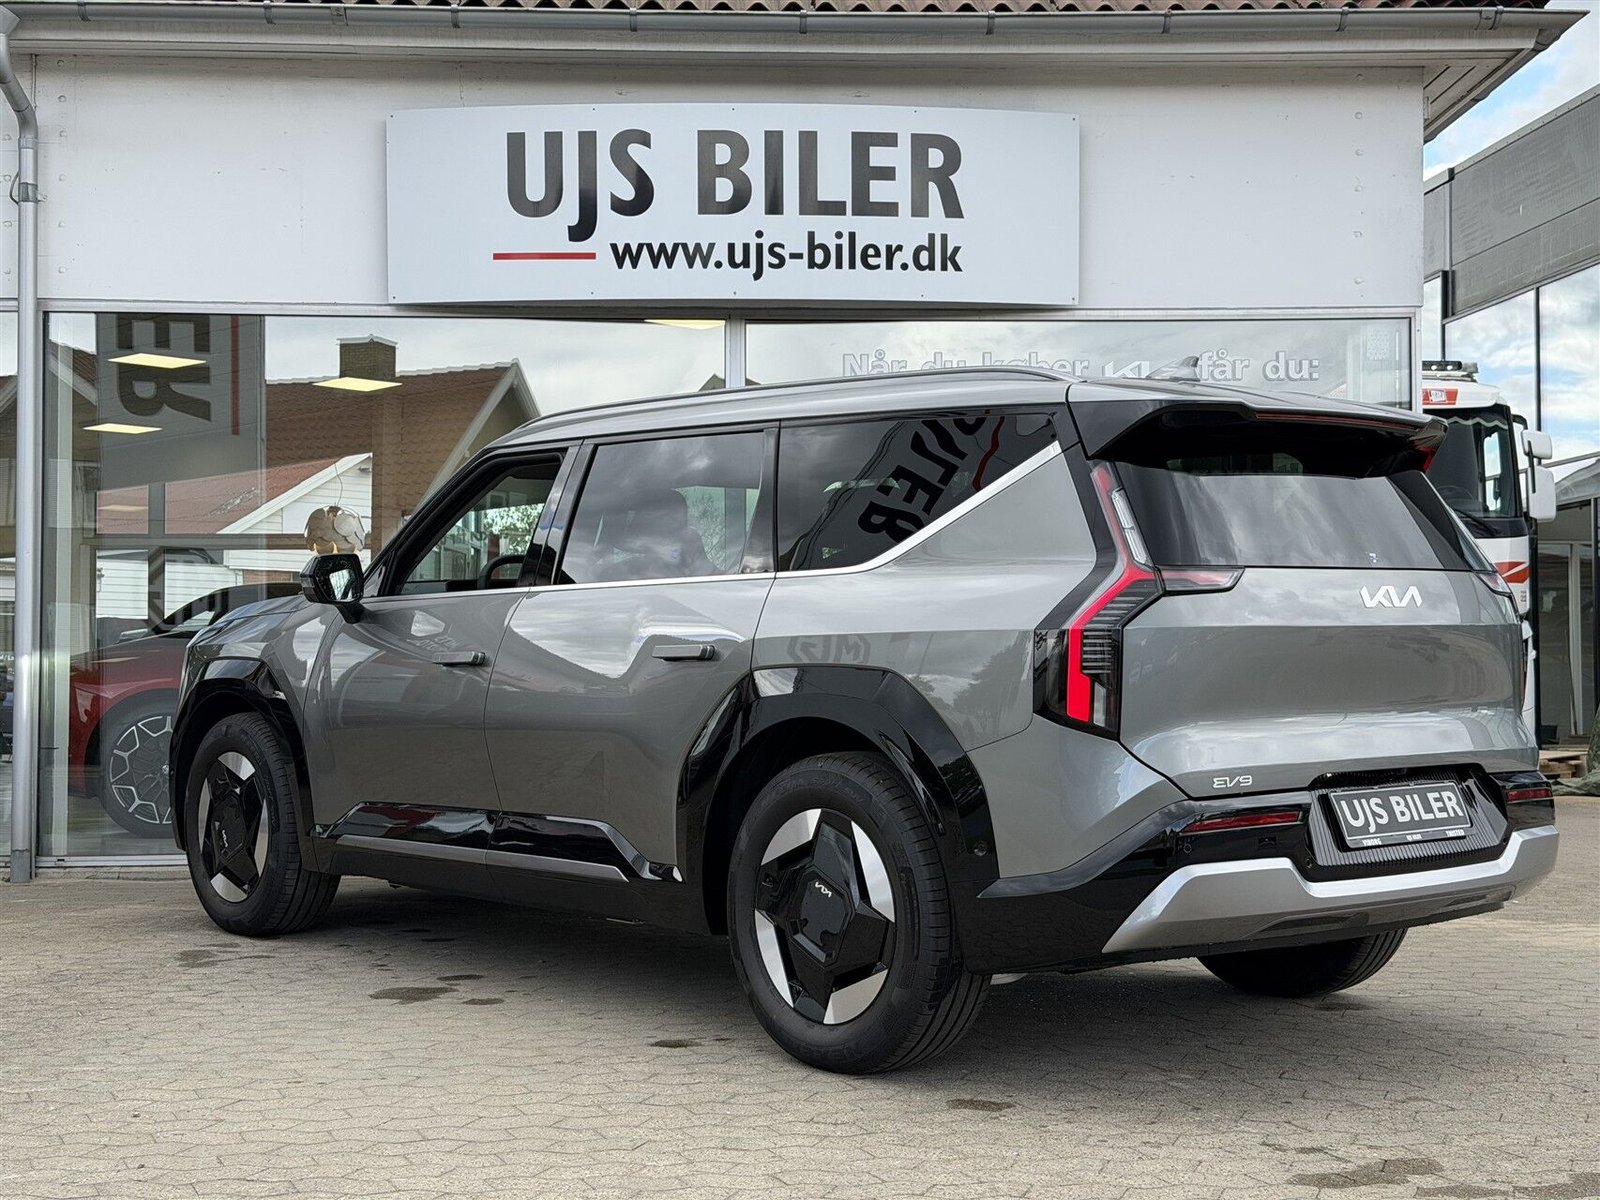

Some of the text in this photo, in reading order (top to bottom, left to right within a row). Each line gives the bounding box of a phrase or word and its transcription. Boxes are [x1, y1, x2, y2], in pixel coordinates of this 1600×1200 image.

[506, 128, 965, 243] UJS BILER
[610, 230, 963, 281] www.ujs-biler.dk
[843, 349, 907, 376] Når
[1199, 348, 1250, 381] får
[1263, 349, 1321, 382] du:
[1359, 585, 1423, 608] KIA
[1212, 774, 1253, 789] EV9
[1343, 791, 1464, 833] UJS BILER
